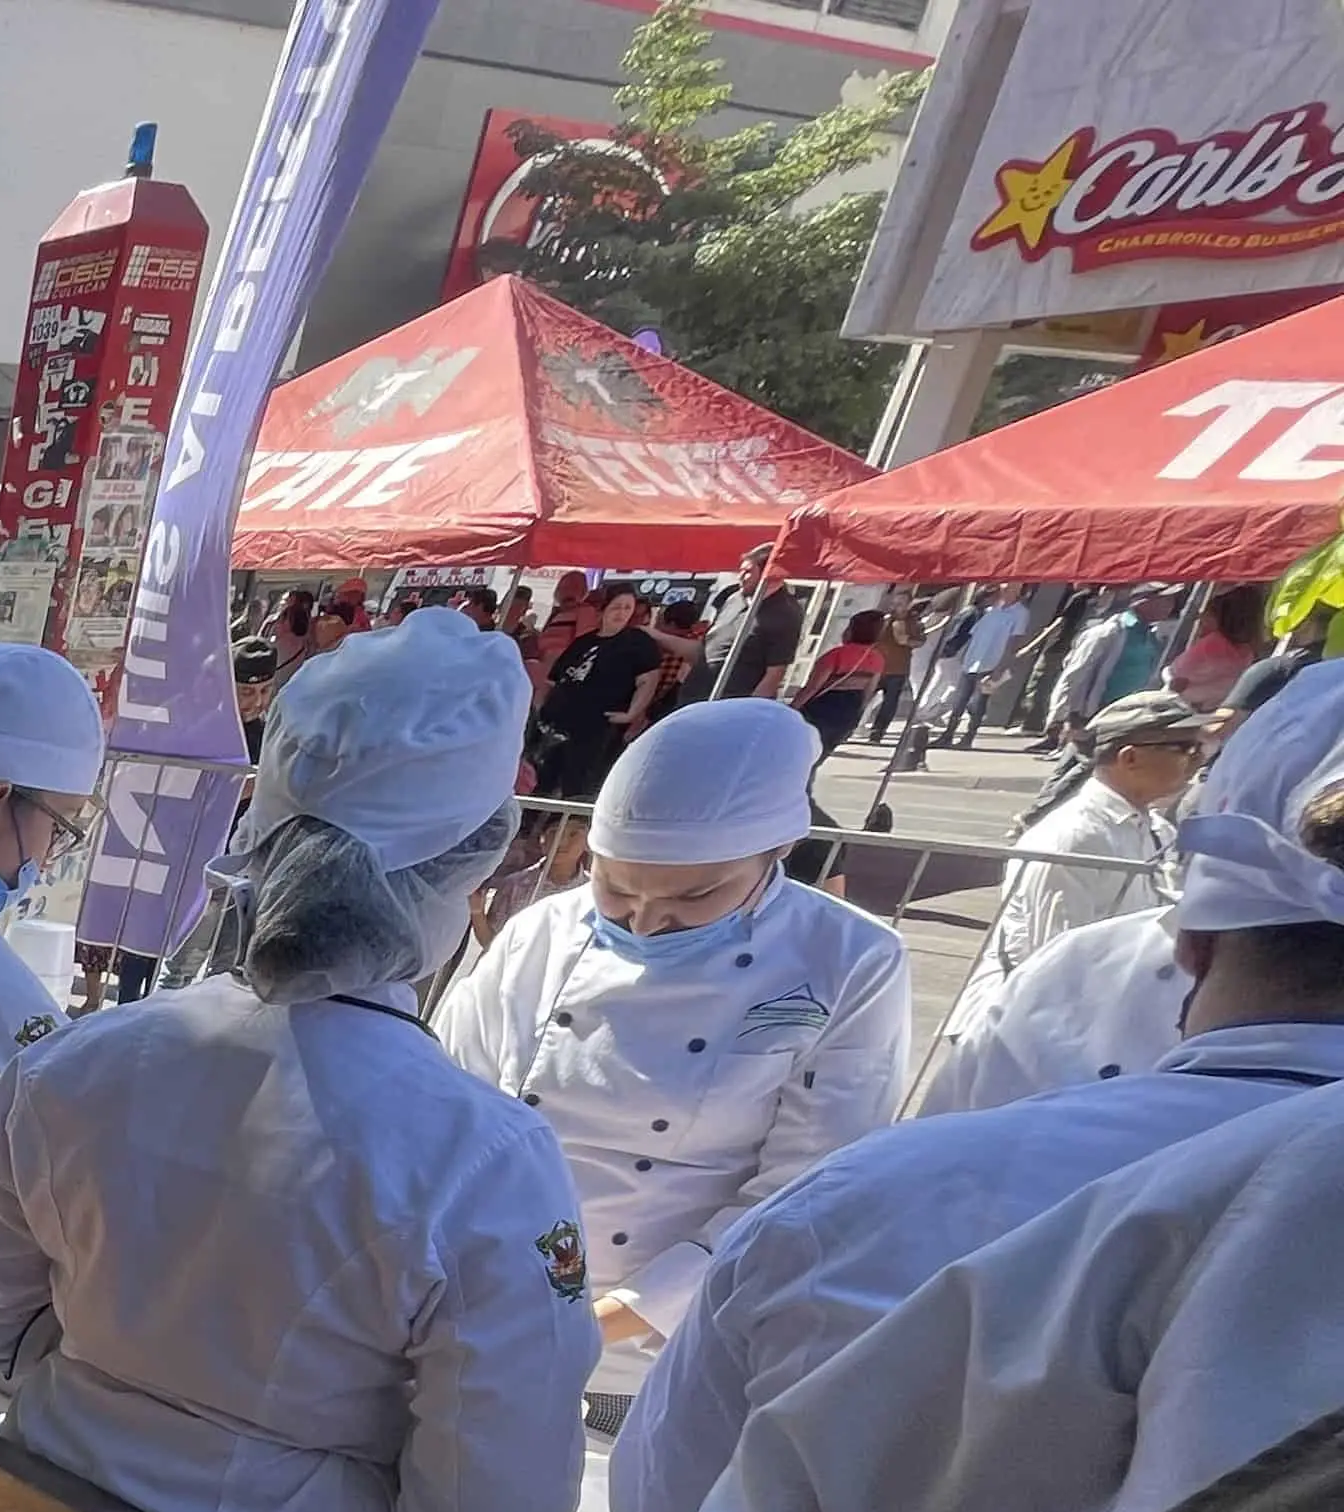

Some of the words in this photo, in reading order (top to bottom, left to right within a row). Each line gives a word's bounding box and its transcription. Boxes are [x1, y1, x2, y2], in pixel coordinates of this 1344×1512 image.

[1053, 110, 1311, 234] Carl's
[55, 259, 114, 288] 066
[144, 258, 198, 281] 066
